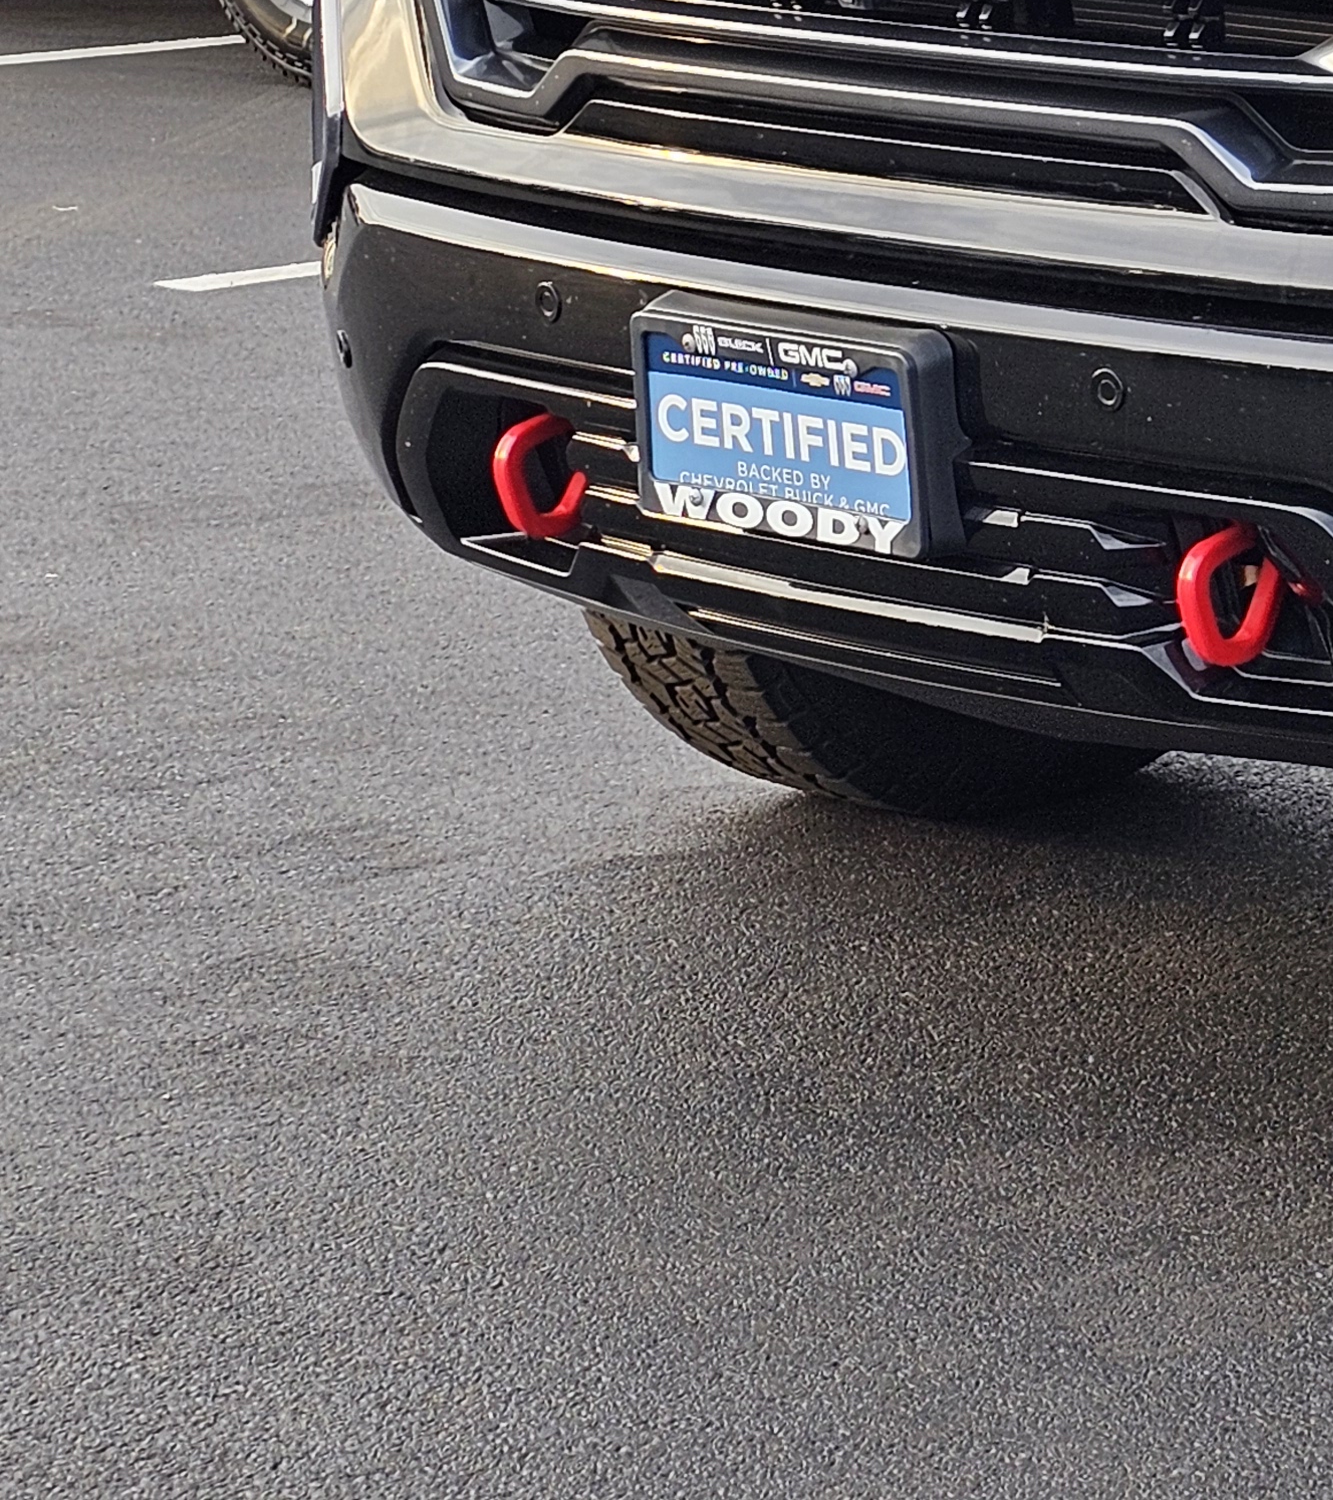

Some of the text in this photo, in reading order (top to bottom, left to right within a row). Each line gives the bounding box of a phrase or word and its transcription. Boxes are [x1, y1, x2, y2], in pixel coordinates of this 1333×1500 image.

[663, 351, 721, 369] CERTIFIED
[717, 336, 845, 371] BUICK GMC
[853, 380, 891, 397] GMC
[657, 394, 907, 477] CERTIFIED
[737, 461, 831, 490] BACKED BY
[680, 471, 778, 498] CHEVROLET
[854, 499, 890, 516] GMC
[654, 482, 906, 555] WOODY
